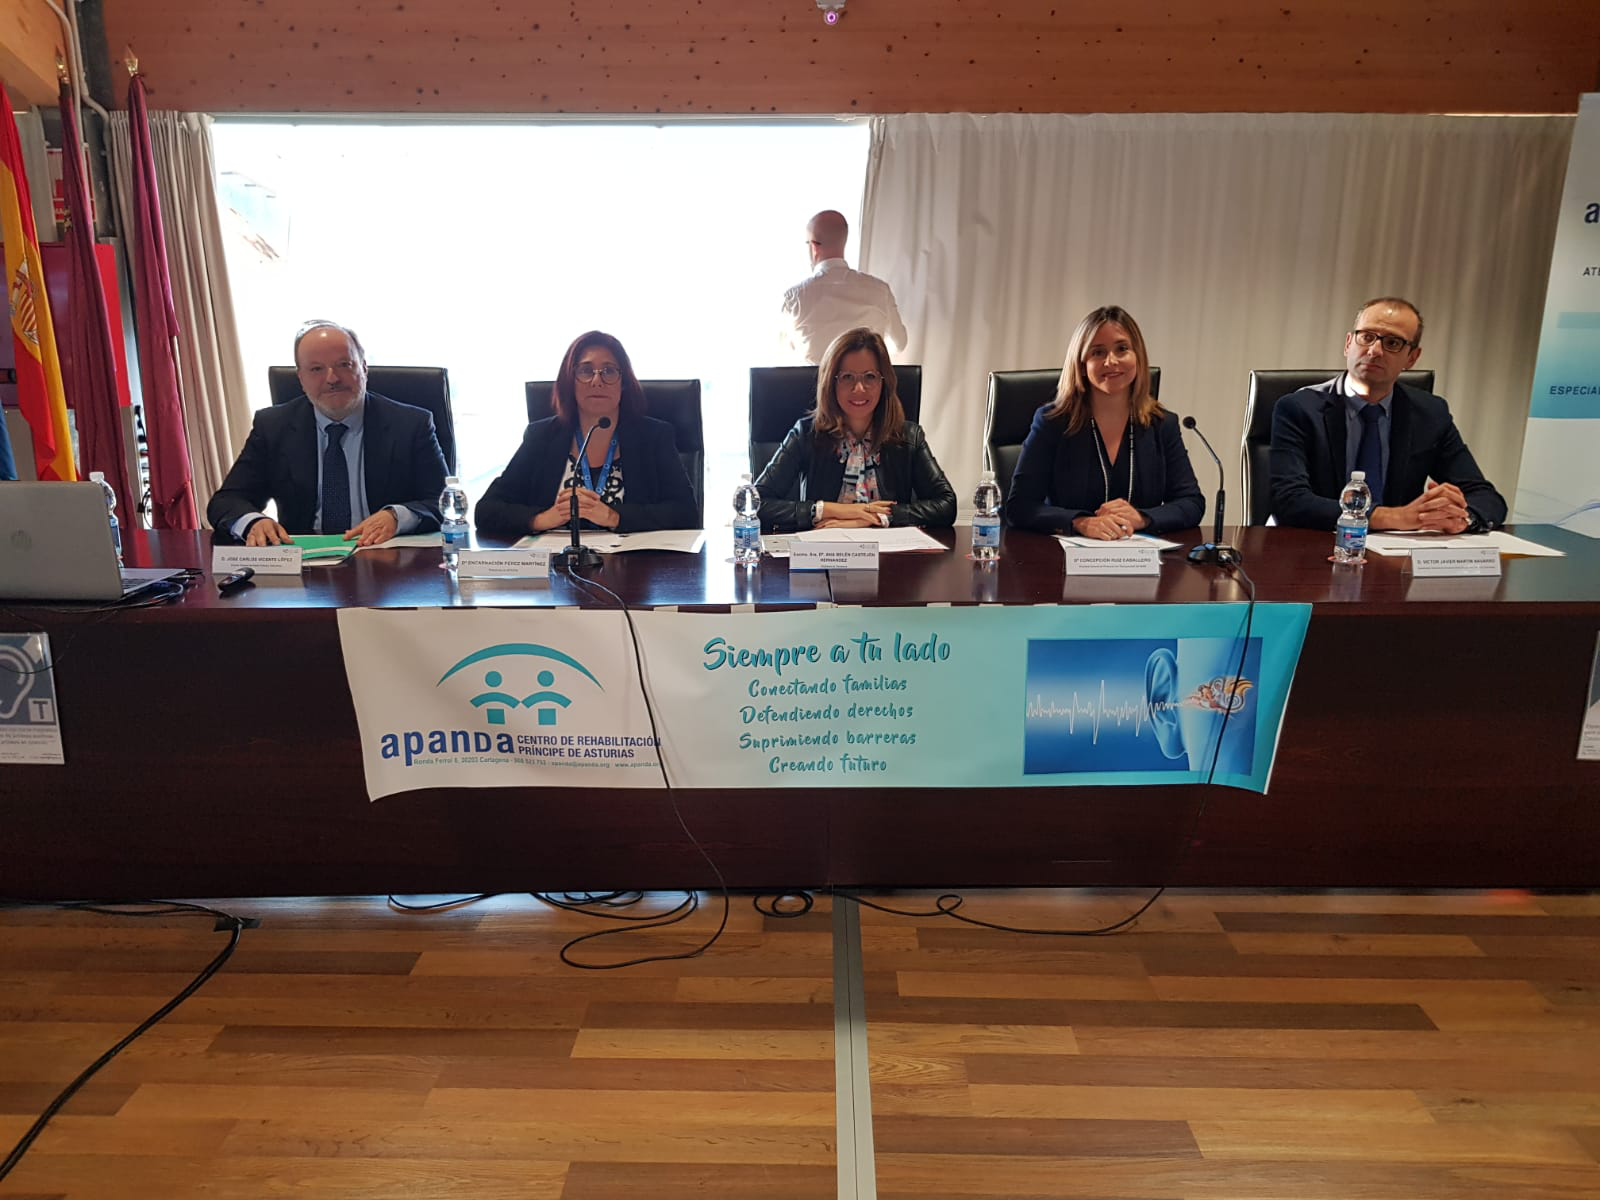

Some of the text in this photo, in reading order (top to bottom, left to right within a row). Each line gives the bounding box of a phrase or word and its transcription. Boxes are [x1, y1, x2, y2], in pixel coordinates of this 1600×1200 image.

[1583, 266, 1600, 276] AT
[1550, 386, 1600, 395] ESPECIA
[704, 632, 951, 676] Siempre a tu lado
[748, 674, 907, 698] Conectando familias
[32, 700, 48, 720] T
[739, 702, 913, 724] Defendiendo derechos
[517, 736, 558, 746] CENTRO
[560, 736, 574, 746] DE
[738, 730, 916, 752] Suprimiendo barreras
[518, 746, 634, 758] PRÍNCIPE DE ASTURIAS
[769, 754, 887, 773] Creando futuro
